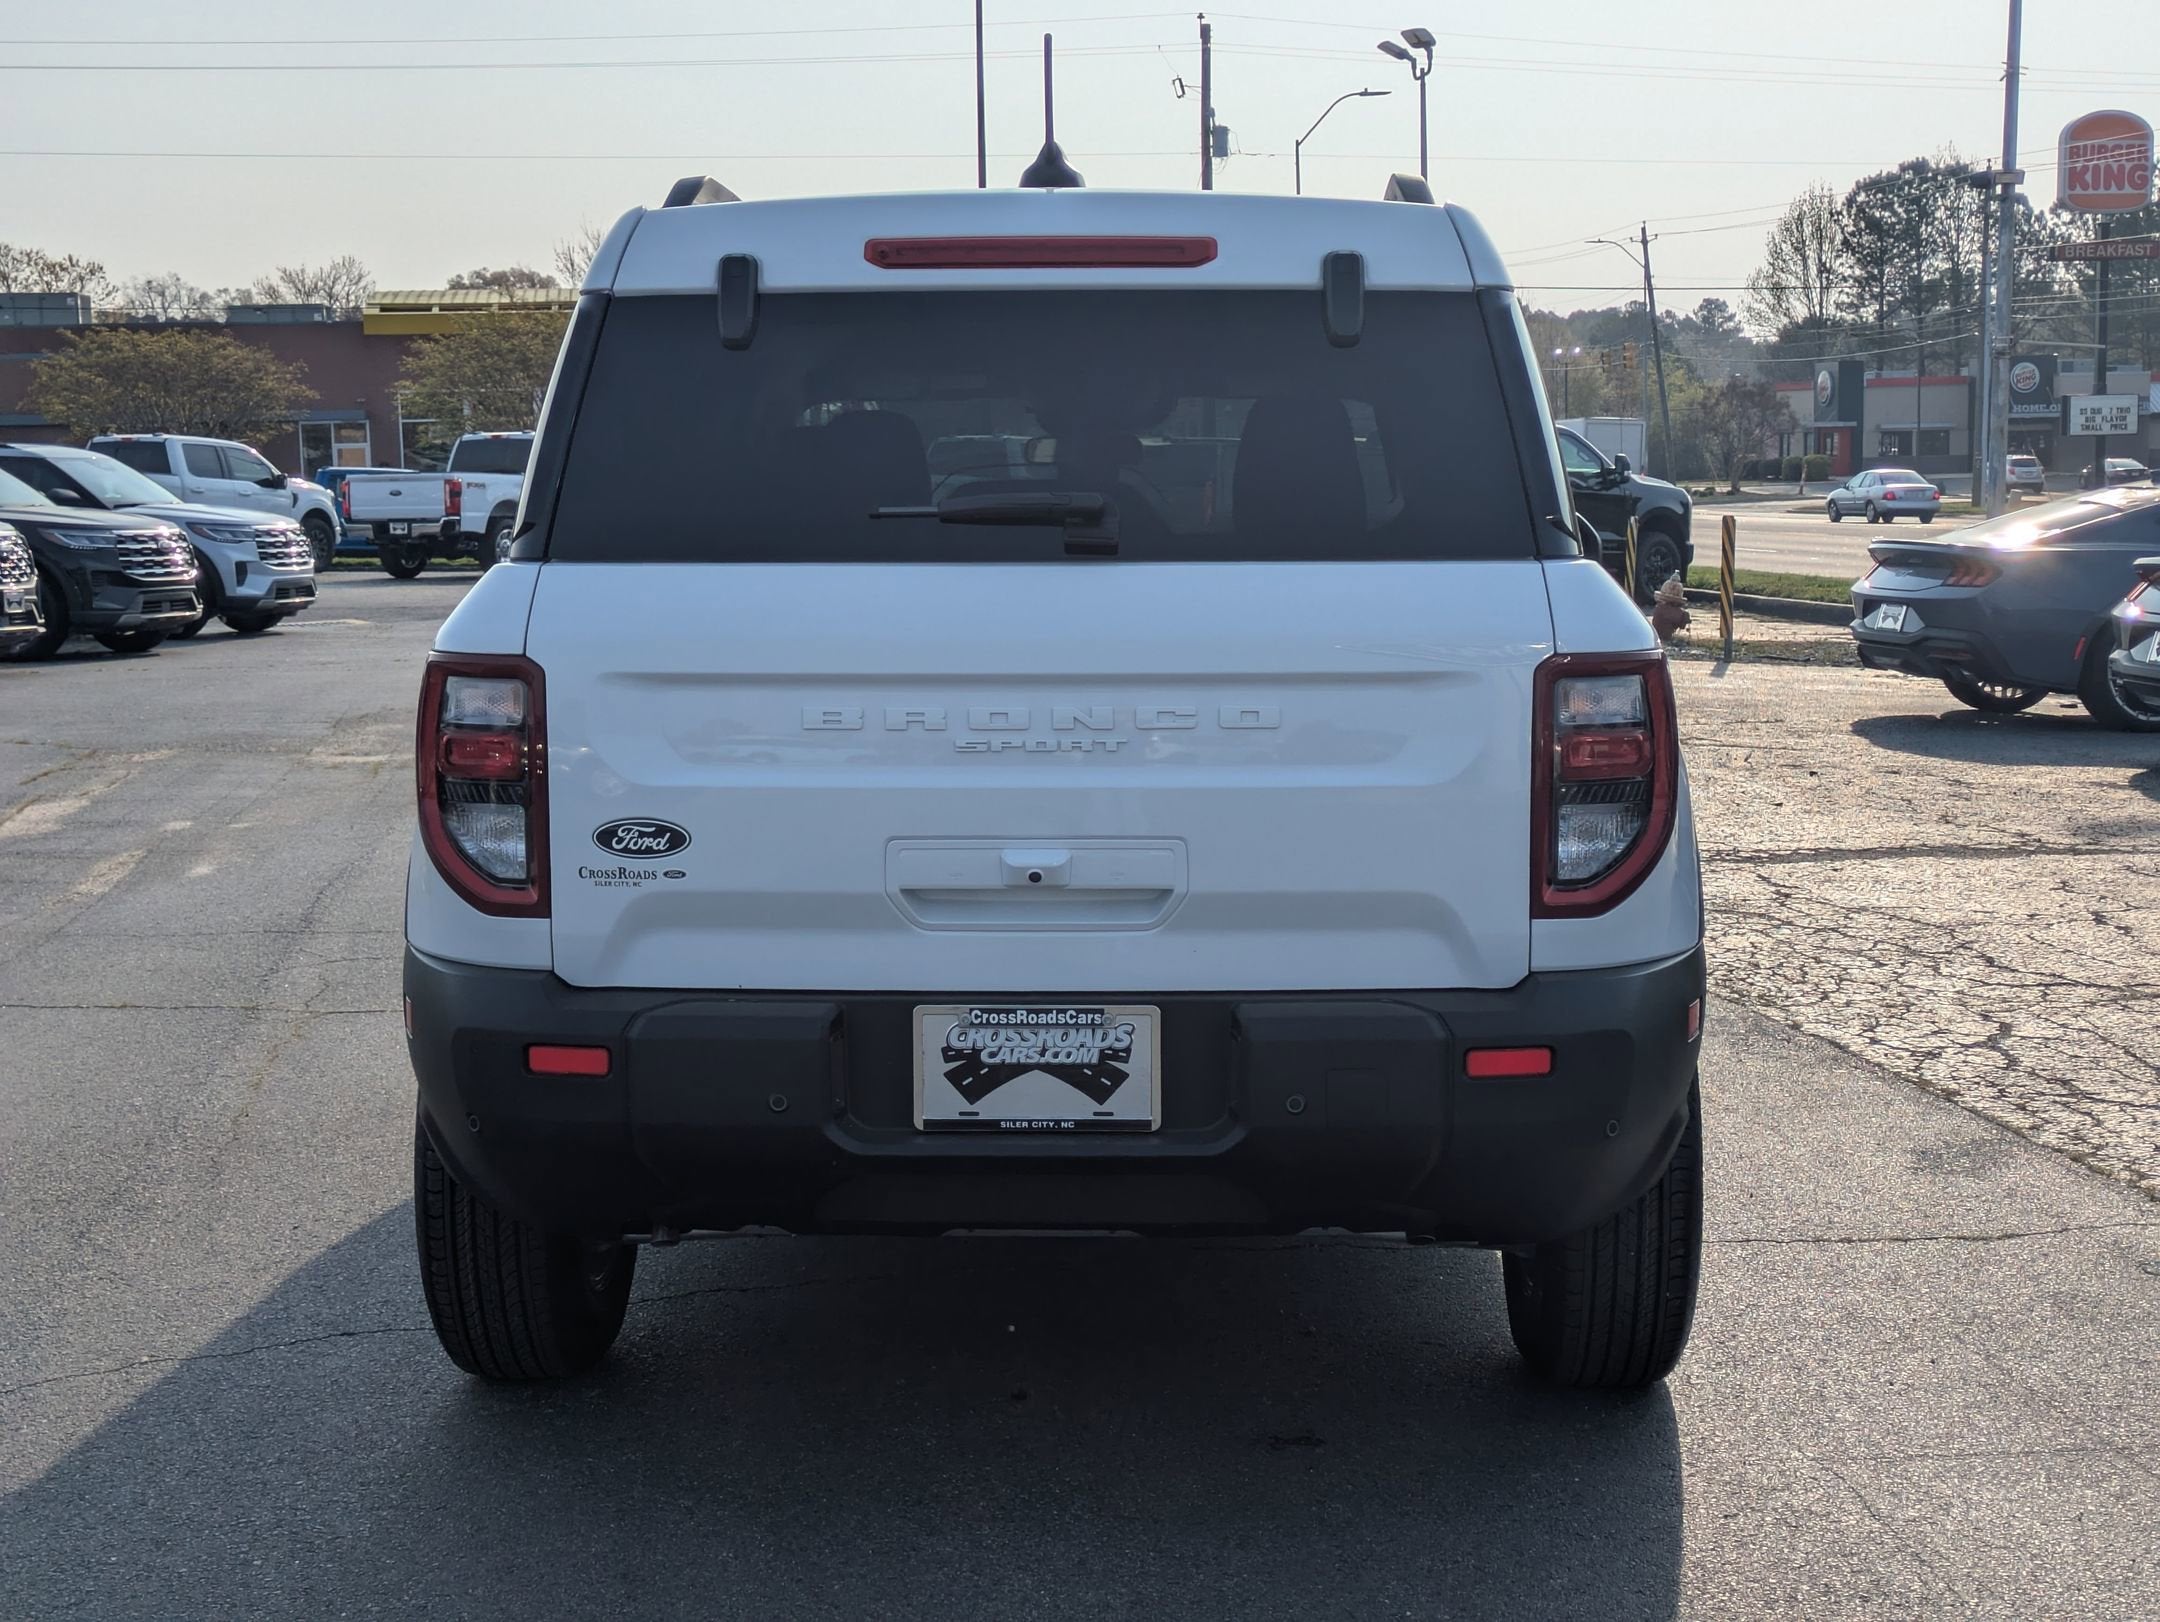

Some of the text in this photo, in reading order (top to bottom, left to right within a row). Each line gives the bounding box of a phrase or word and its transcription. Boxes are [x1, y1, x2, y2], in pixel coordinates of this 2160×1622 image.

[2068, 143, 2149, 164] BURGER
[2067, 163, 2149, 191] KING
[2065, 244, 2153, 258] BREAKFAST
[2013, 404, 2049, 412] HOME
[2116, 406, 2131, 414] TRIO
[2102, 415, 2128, 423] FLAVOR
[2110, 423, 2128, 431] PRICE
[802, 705, 1281, 731] BRONCO
[954, 738, 1129, 753] SPORT
[611, 825, 671, 850] Ford
[613, 880, 631, 888] CITY,
[970, 1009, 1102, 1026] CrossRoadsCars
[946, 1024, 1136, 1050] CROSSROADS
[980, 1047, 1101, 1066] CARS.COM
[1000, 1120, 1075, 1129] SILER CITY, NC
